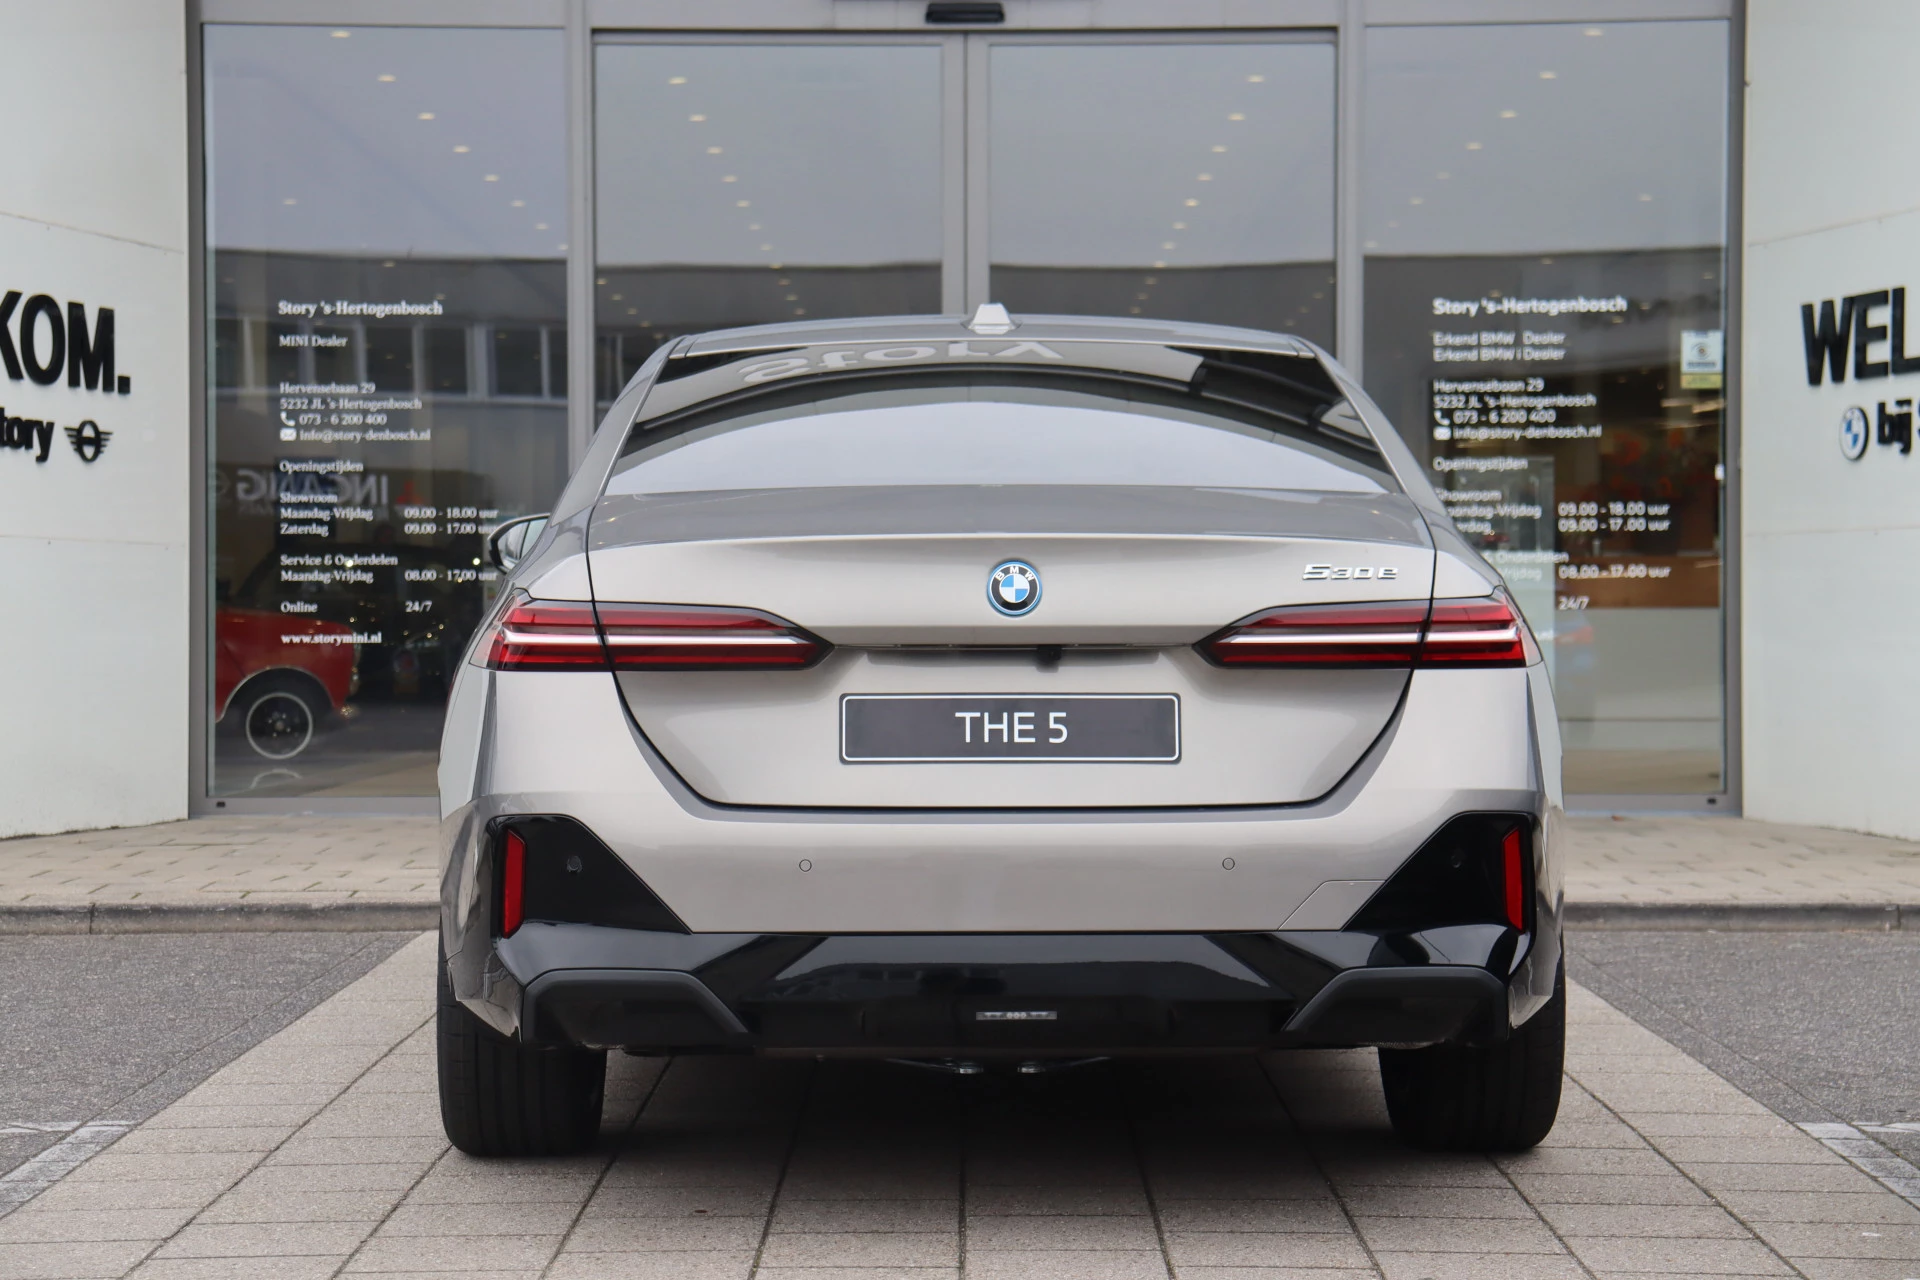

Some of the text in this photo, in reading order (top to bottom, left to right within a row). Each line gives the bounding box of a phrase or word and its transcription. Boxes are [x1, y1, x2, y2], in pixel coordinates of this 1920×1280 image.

[278, 300, 443, 318] Story 's-Hertogenbosch
[1433, 296, 1627, 317] Story 's-Hertogenbosch
[279, 334, 348, 347] MINI Dealer
[1433, 331, 1565, 345] Erkend BMW Dealer
[1433, 347, 1478, 361] Erkend
[1480, 348, 1514, 361] BMW
[1523, 347, 1565, 360] Dealer
[280, 382, 376, 394] Hervensebaan 29
[1433, 377, 1545, 393] Hervensebaan 29
[280, 398, 422, 412] 5232 JL 's-Hertogenbosch
[1433, 393, 1597, 409] 5232 JL 's-Hertogenbosch
[299, 413, 321, 425] 073
[330, 413, 339, 425] 6
[341, 413, 363, 425] 200
[365, 413, 387, 425] 400
[1453, 409, 1478, 424] 073
[1488, 409, 1499, 424] 6
[1500, 409, 1527, 423] 200
[1529, 408, 1556, 423] 400
[300, 428, 431, 443] info@story-denbosch.nl
[1453, 424, 1602, 441] info@story-denbosch.nl
[279, 460, 363, 474] Openingstijden
[1433, 456, 1528, 471] Openingstijden
[280, 491, 338, 503] Showroom
[280, 507, 373, 521] Maandag-Vrijdag
[404, 507, 436, 518] 09.00
[446, 507, 477, 518] 18.00
[478, 509, 498, 518] uur
[1558, 501, 1598, 516] 09.00
[1608, 501, 1646, 516] 18.00
[1647, 504, 1670, 515] uur
[280, 522, 329, 537] Zaterdag
[404, 523, 436, 534] 09.00
[446, 523, 476, 534] 17.00
[1558, 517, 1598, 532] 09.00
[1647, 520, 1671, 531] uur
[280, 554, 322, 566] Service
[324, 554, 332, 565] &
[280, 569, 373, 583] Maandag-Vrijdag
[404, 570, 437, 581] 08.00
[446, 570, 476, 581] 17.00
[478, 572, 498, 581] uur
[995, 566, 1035, 581] BMW
[1559, 565, 1599, 579] 08.00
[1648, 567, 1671, 578] uur
[280, 601, 432, 613] Online 24/7
[1559, 595, 1590, 610] 24/7
[281, 632, 382, 645] www.storymini.nl
[955, 711, 1068, 744] THE 5
